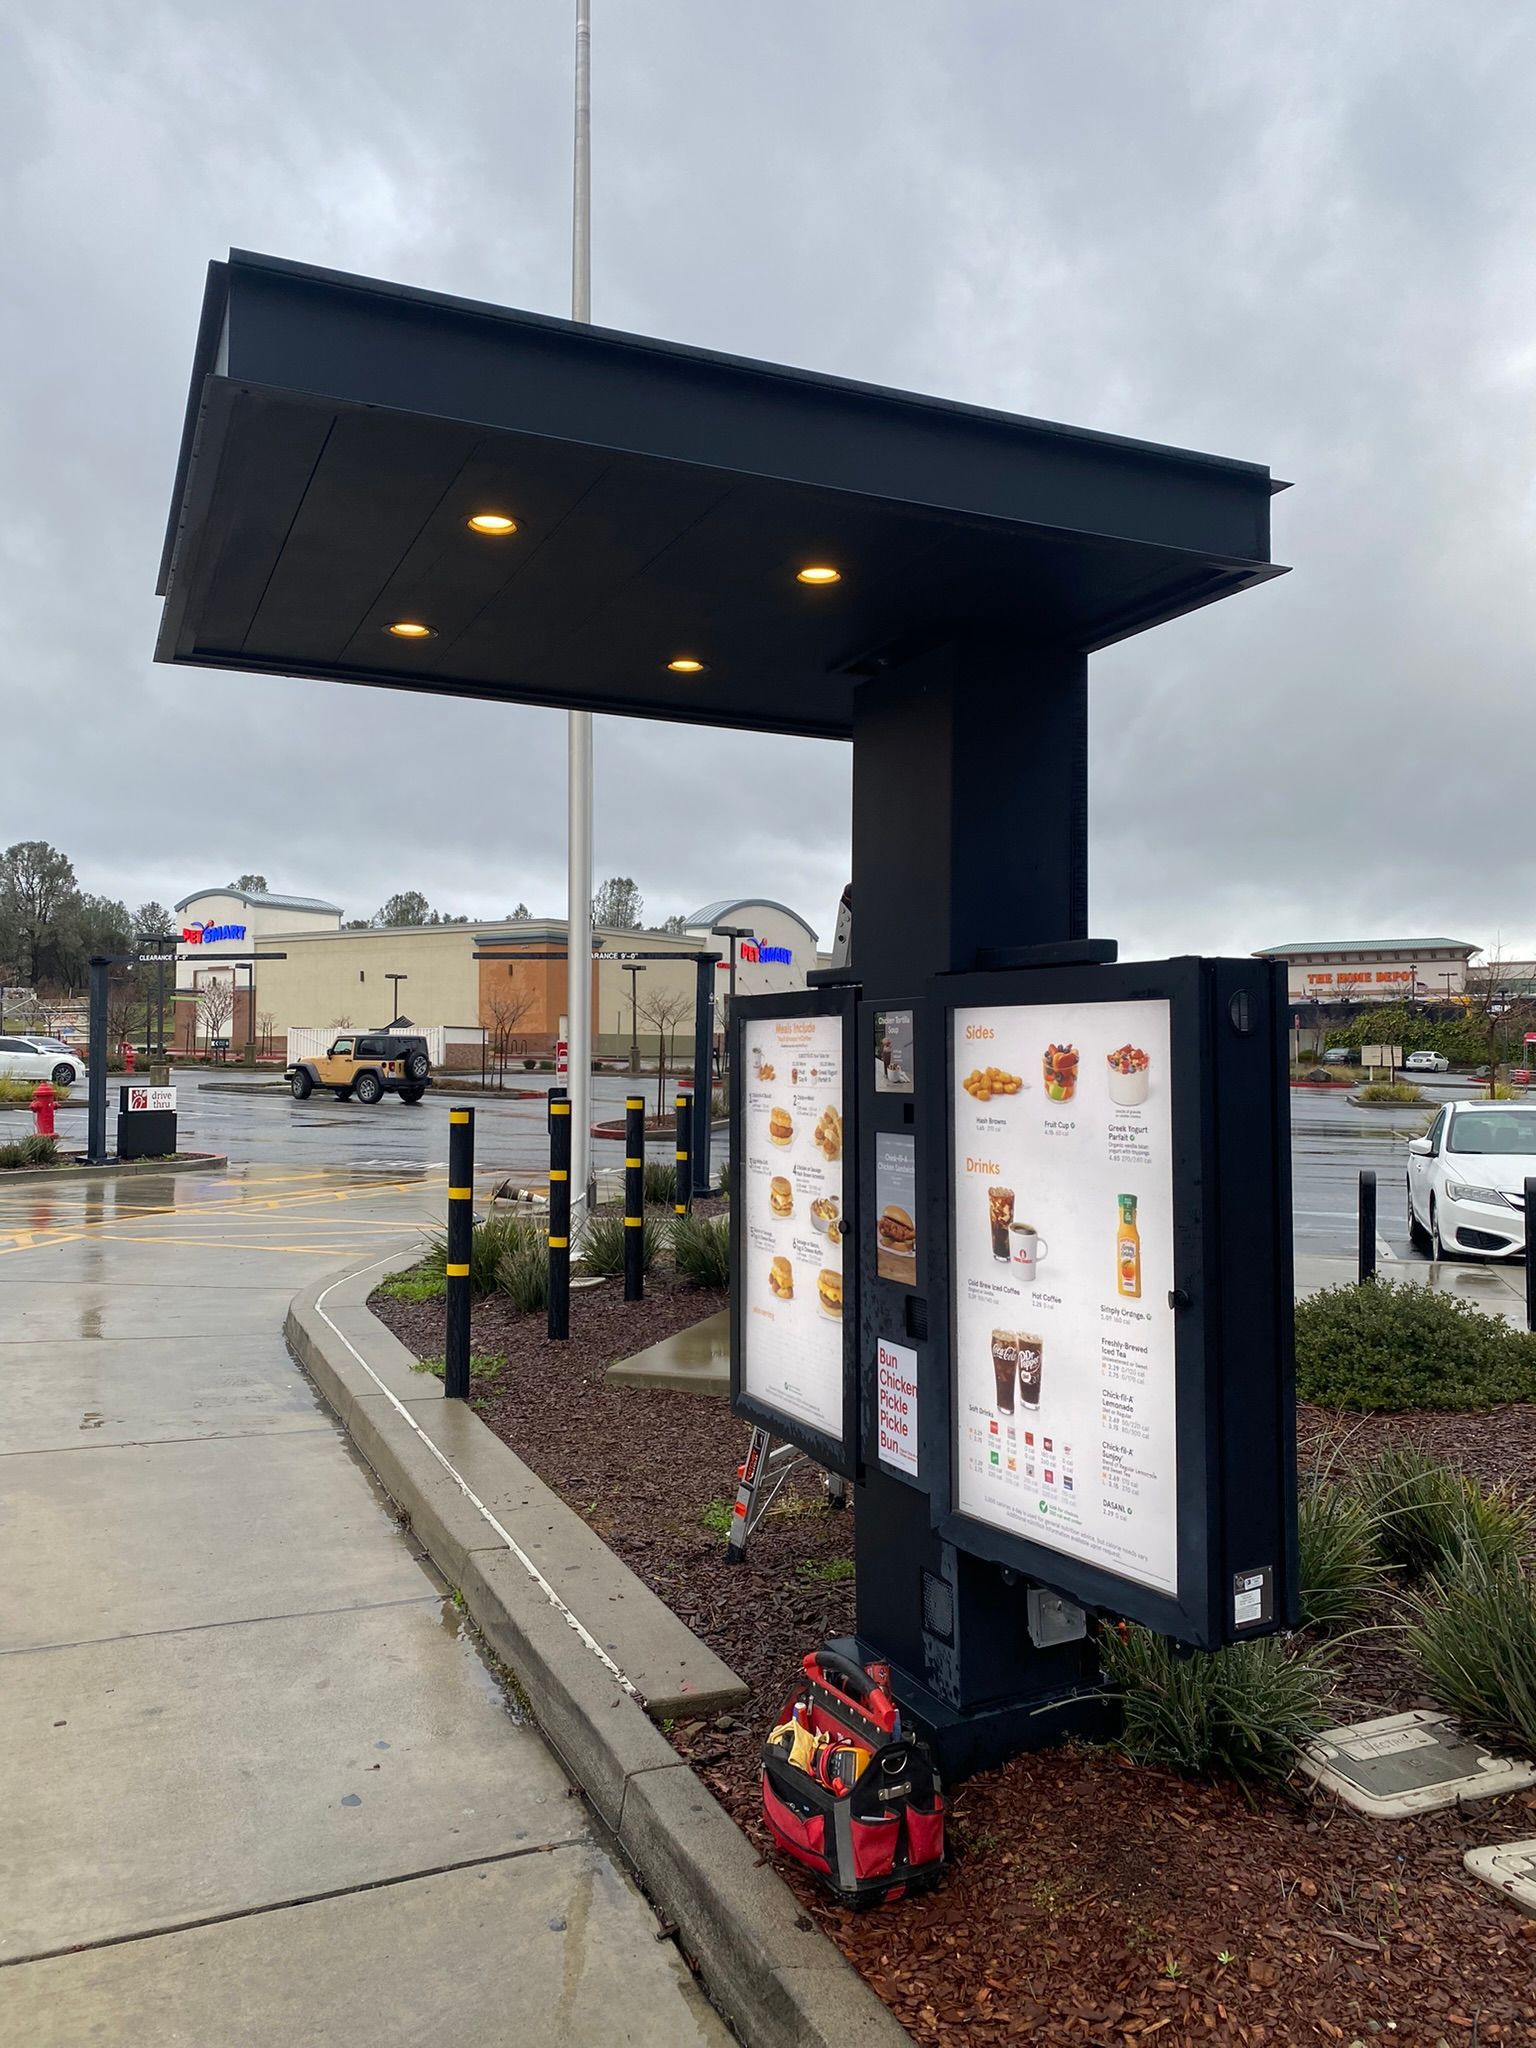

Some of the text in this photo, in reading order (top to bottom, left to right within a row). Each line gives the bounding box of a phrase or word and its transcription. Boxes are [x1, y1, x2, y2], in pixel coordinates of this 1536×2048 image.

[182, 921, 246, 944] PETSMART
[741, 939, 792, 965] PETSMART
[1307, 970, 1417, 985] THE HOME DEPOT
[888, 1025, 899, 1035] Soup
[966, 1025, 994, 1039] Sides
[152, 1091, 172, 1100] drive
[153, 1100, 171, 1109] thru
[1058, 1121, 1069, 1130] Cup
[1108, 1124, 1148, 1134] Greek Yogurt
[1108, 1133, 1128, 1141] Parfait
[966, 1157, 1000, 1175] Drinks
[968, 1279, 979, 1287] Cold
[980, 1281, 991, 1289] Brew
[992, 1283, 1002, 1292] Iced
[1004, 1285, 1020, 1296] Coffee
[1032, 1292, 1062, 1303] Hot Coffee
[1100, 1304, 1120, 1316] Simply
[1101, 1337, 1148, 1354] Freshly-Brewed
[1101, 1346, 1127, 1358] Iced Tea
[880, 1348, 898, 1369] Bun
[880, 1369, 918, 1398] Chicken
[880, 1389, 908, 1415] Pickle
[1102, 1399, 1134, 1412] Lemonade
[969, 1404, 994, 1418] Soft Drinks
[880, 1409, 908, 1436] Pickle
[880, 1431, 899, 1454] Bun
